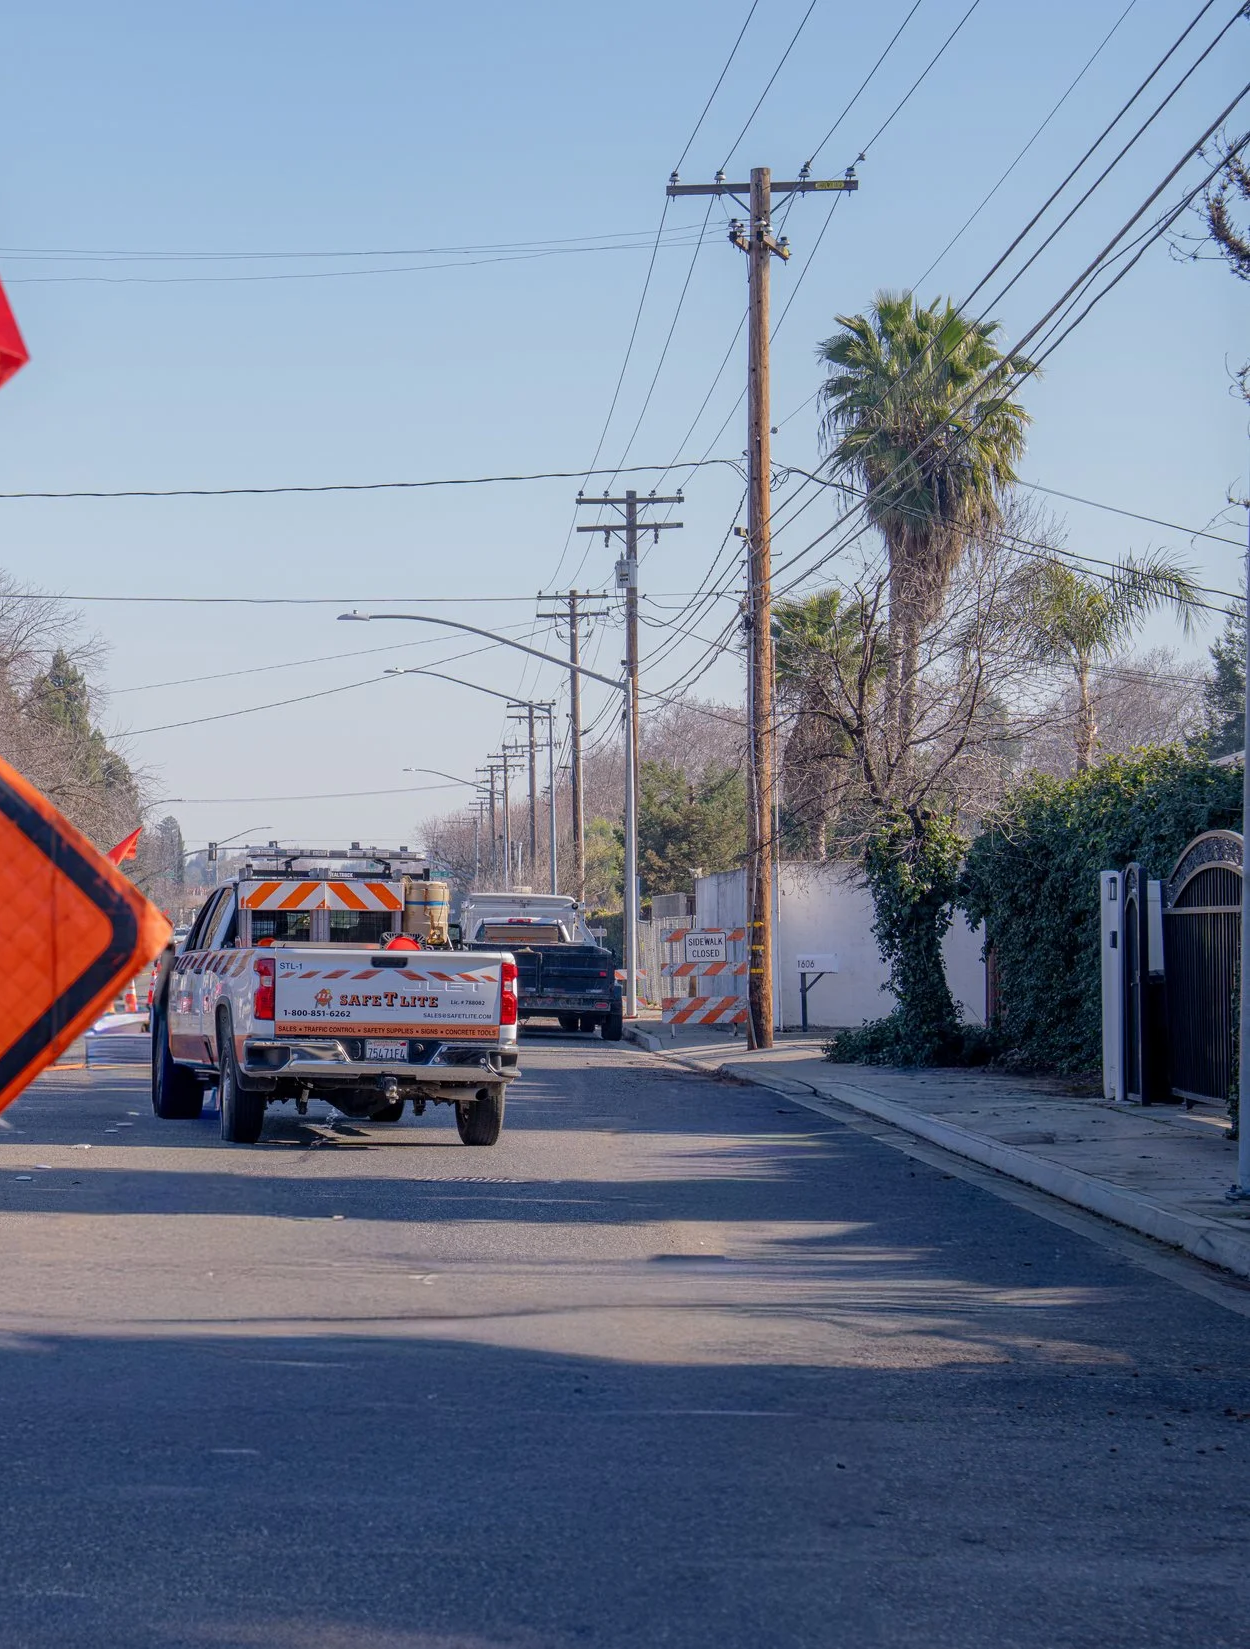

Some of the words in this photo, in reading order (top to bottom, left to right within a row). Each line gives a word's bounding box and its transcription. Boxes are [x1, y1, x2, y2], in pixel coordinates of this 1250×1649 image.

[688, 937, 723, 947] SIDEWALK
[692, 949, 720, 958] CLOSED
[279, 962, 303, 970] STL-1
[797, 959, 815, 968] 1606
[283, 1009, 351, 1018] 1-800-851-6262
[423, 1012, 492, 1020] SALES@SAFETLITE.COM
[386, 1027, 414, 1035] SUPPLIES
[445, 1028, 476, 1036] CONCRETE
[368, 1048, 405, 1059] 75471F4
